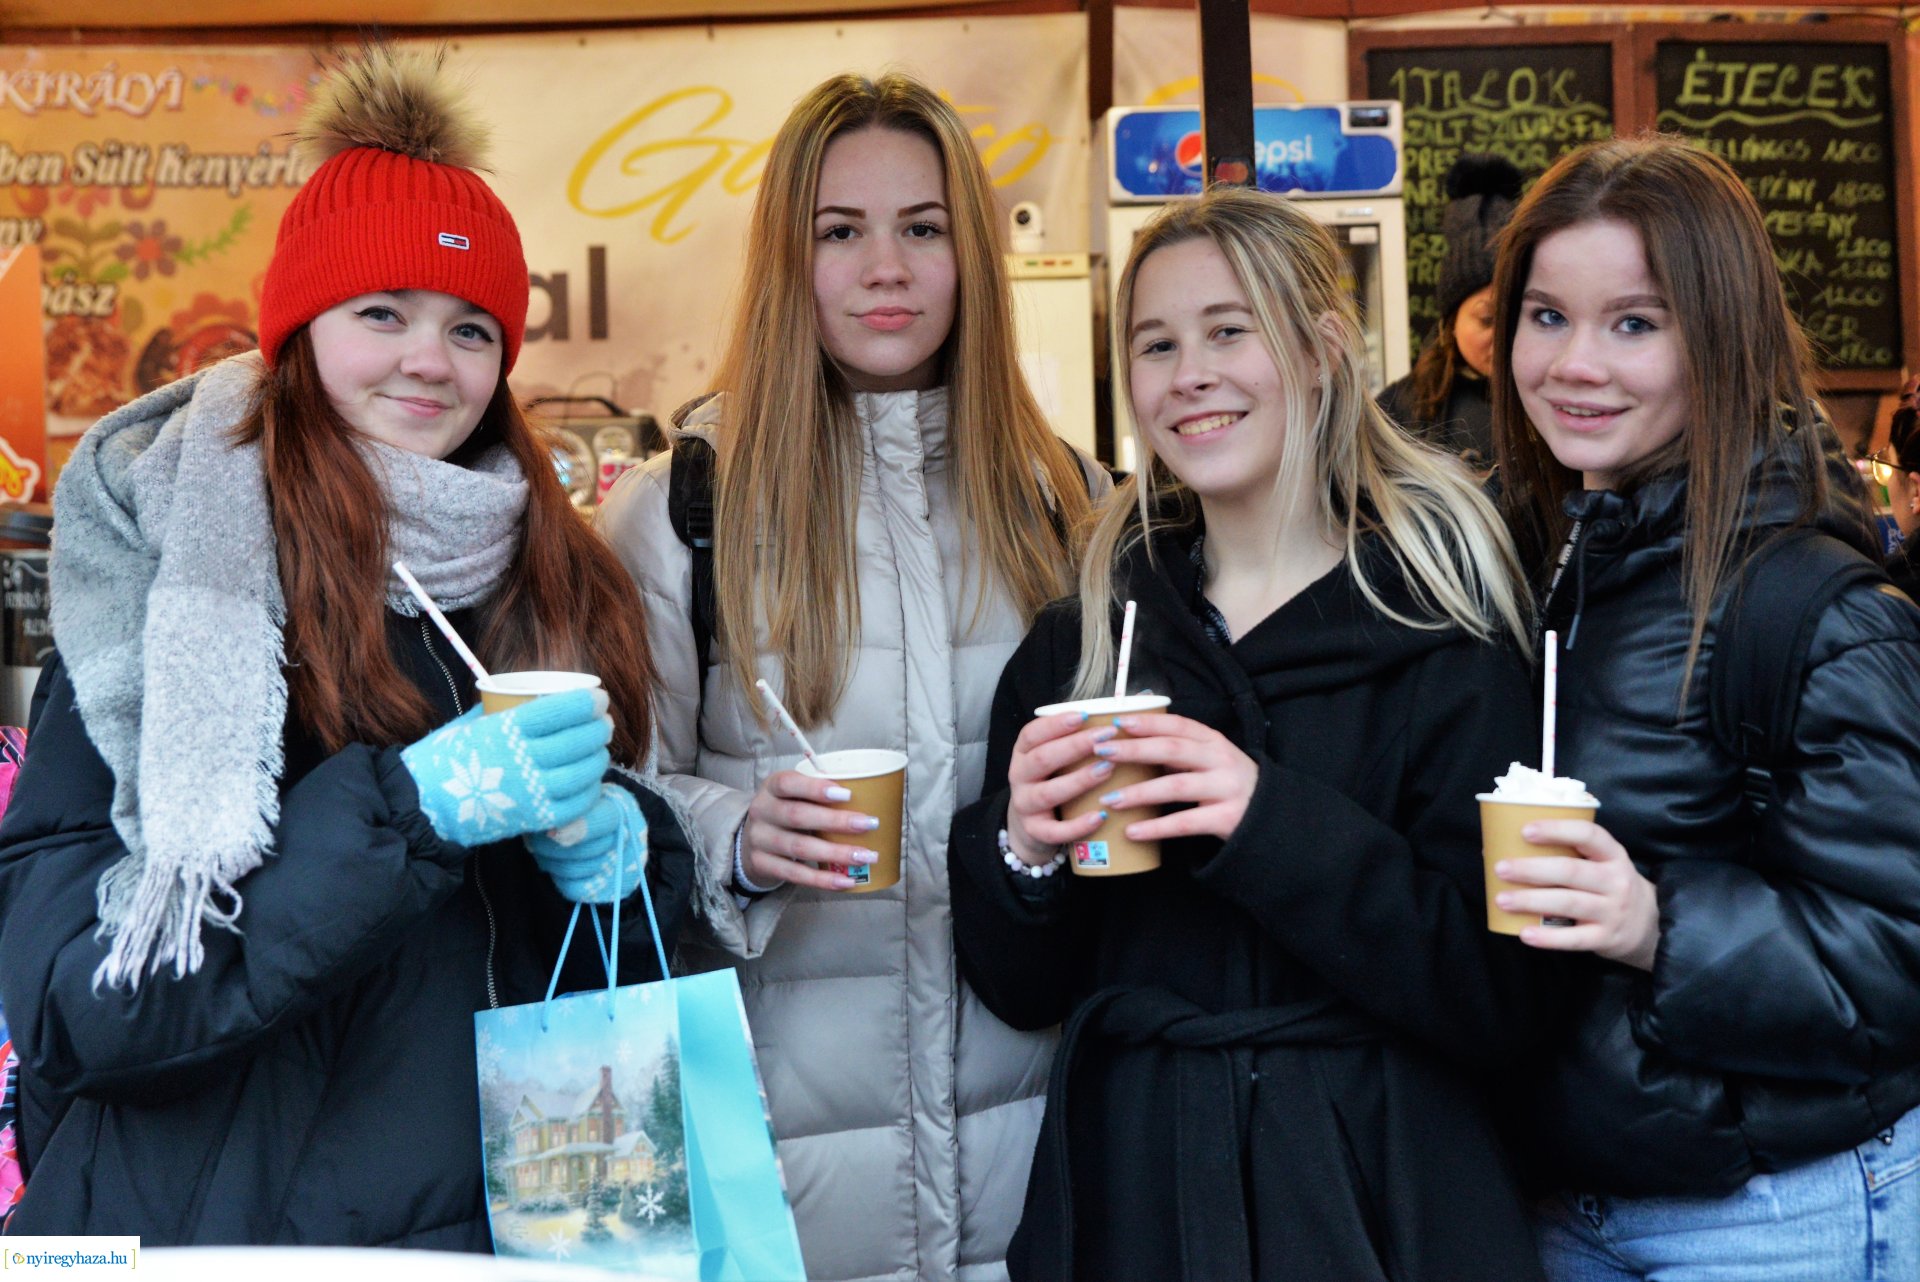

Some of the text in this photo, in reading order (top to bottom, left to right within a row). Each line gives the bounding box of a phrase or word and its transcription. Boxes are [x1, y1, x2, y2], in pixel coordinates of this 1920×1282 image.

[1675, 48, 1877, 108] ÉTELEK
[72, 140, 152, 187] Sült
[155, 142, 308, 199] Kenyérl
[1254, 134, 1312, 170] epsi
